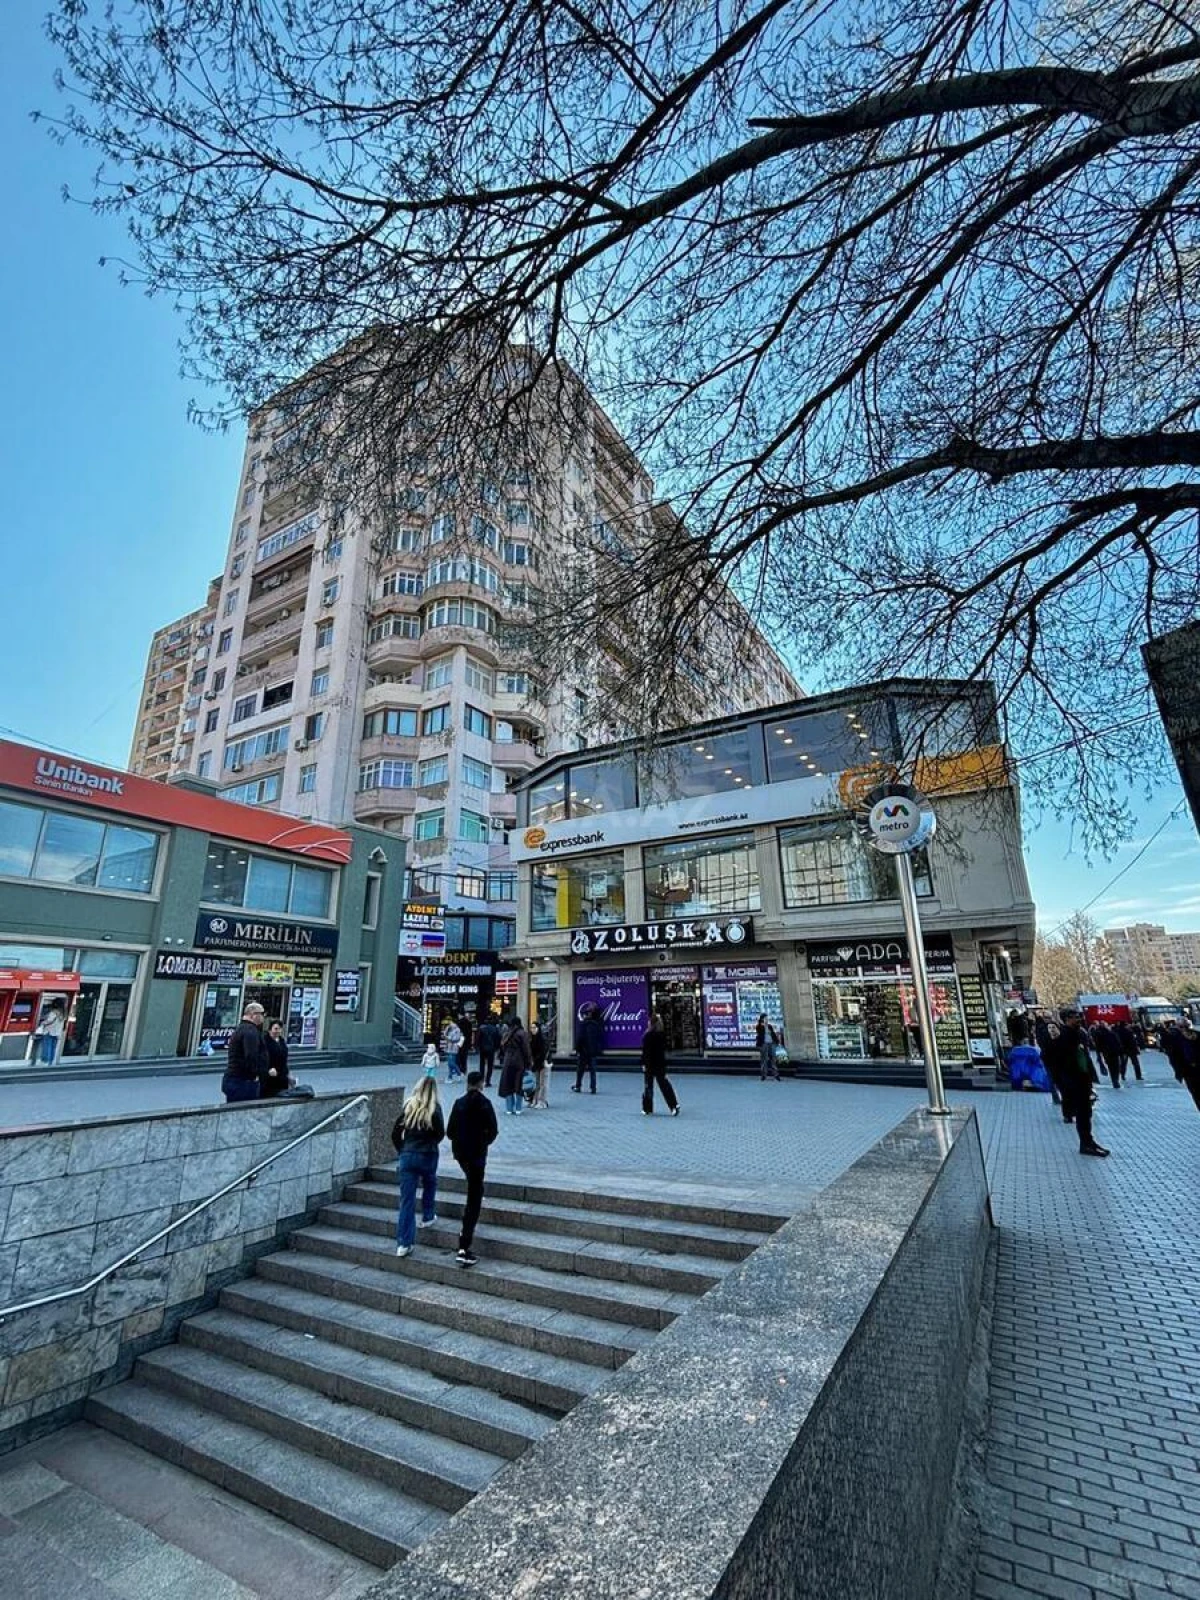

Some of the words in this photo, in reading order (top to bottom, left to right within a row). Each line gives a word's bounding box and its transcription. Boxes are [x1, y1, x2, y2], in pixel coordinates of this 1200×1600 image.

[36, 757, 125, 796] Unibank
[879, 821, 909, 832] metro
[539, 830, 605, 852] expressbank
[234, 923, 313, 945] MERİLİN
[855, 943, 902, 961] ADA
[156, 955, 220, 976] LOMBARD
[414, 965, 446, 977] LAZER
[458, 985, 479, 994] KING
[599, 987, 621, 997] Saat
[601, 1001, 646, 1022] Murat
